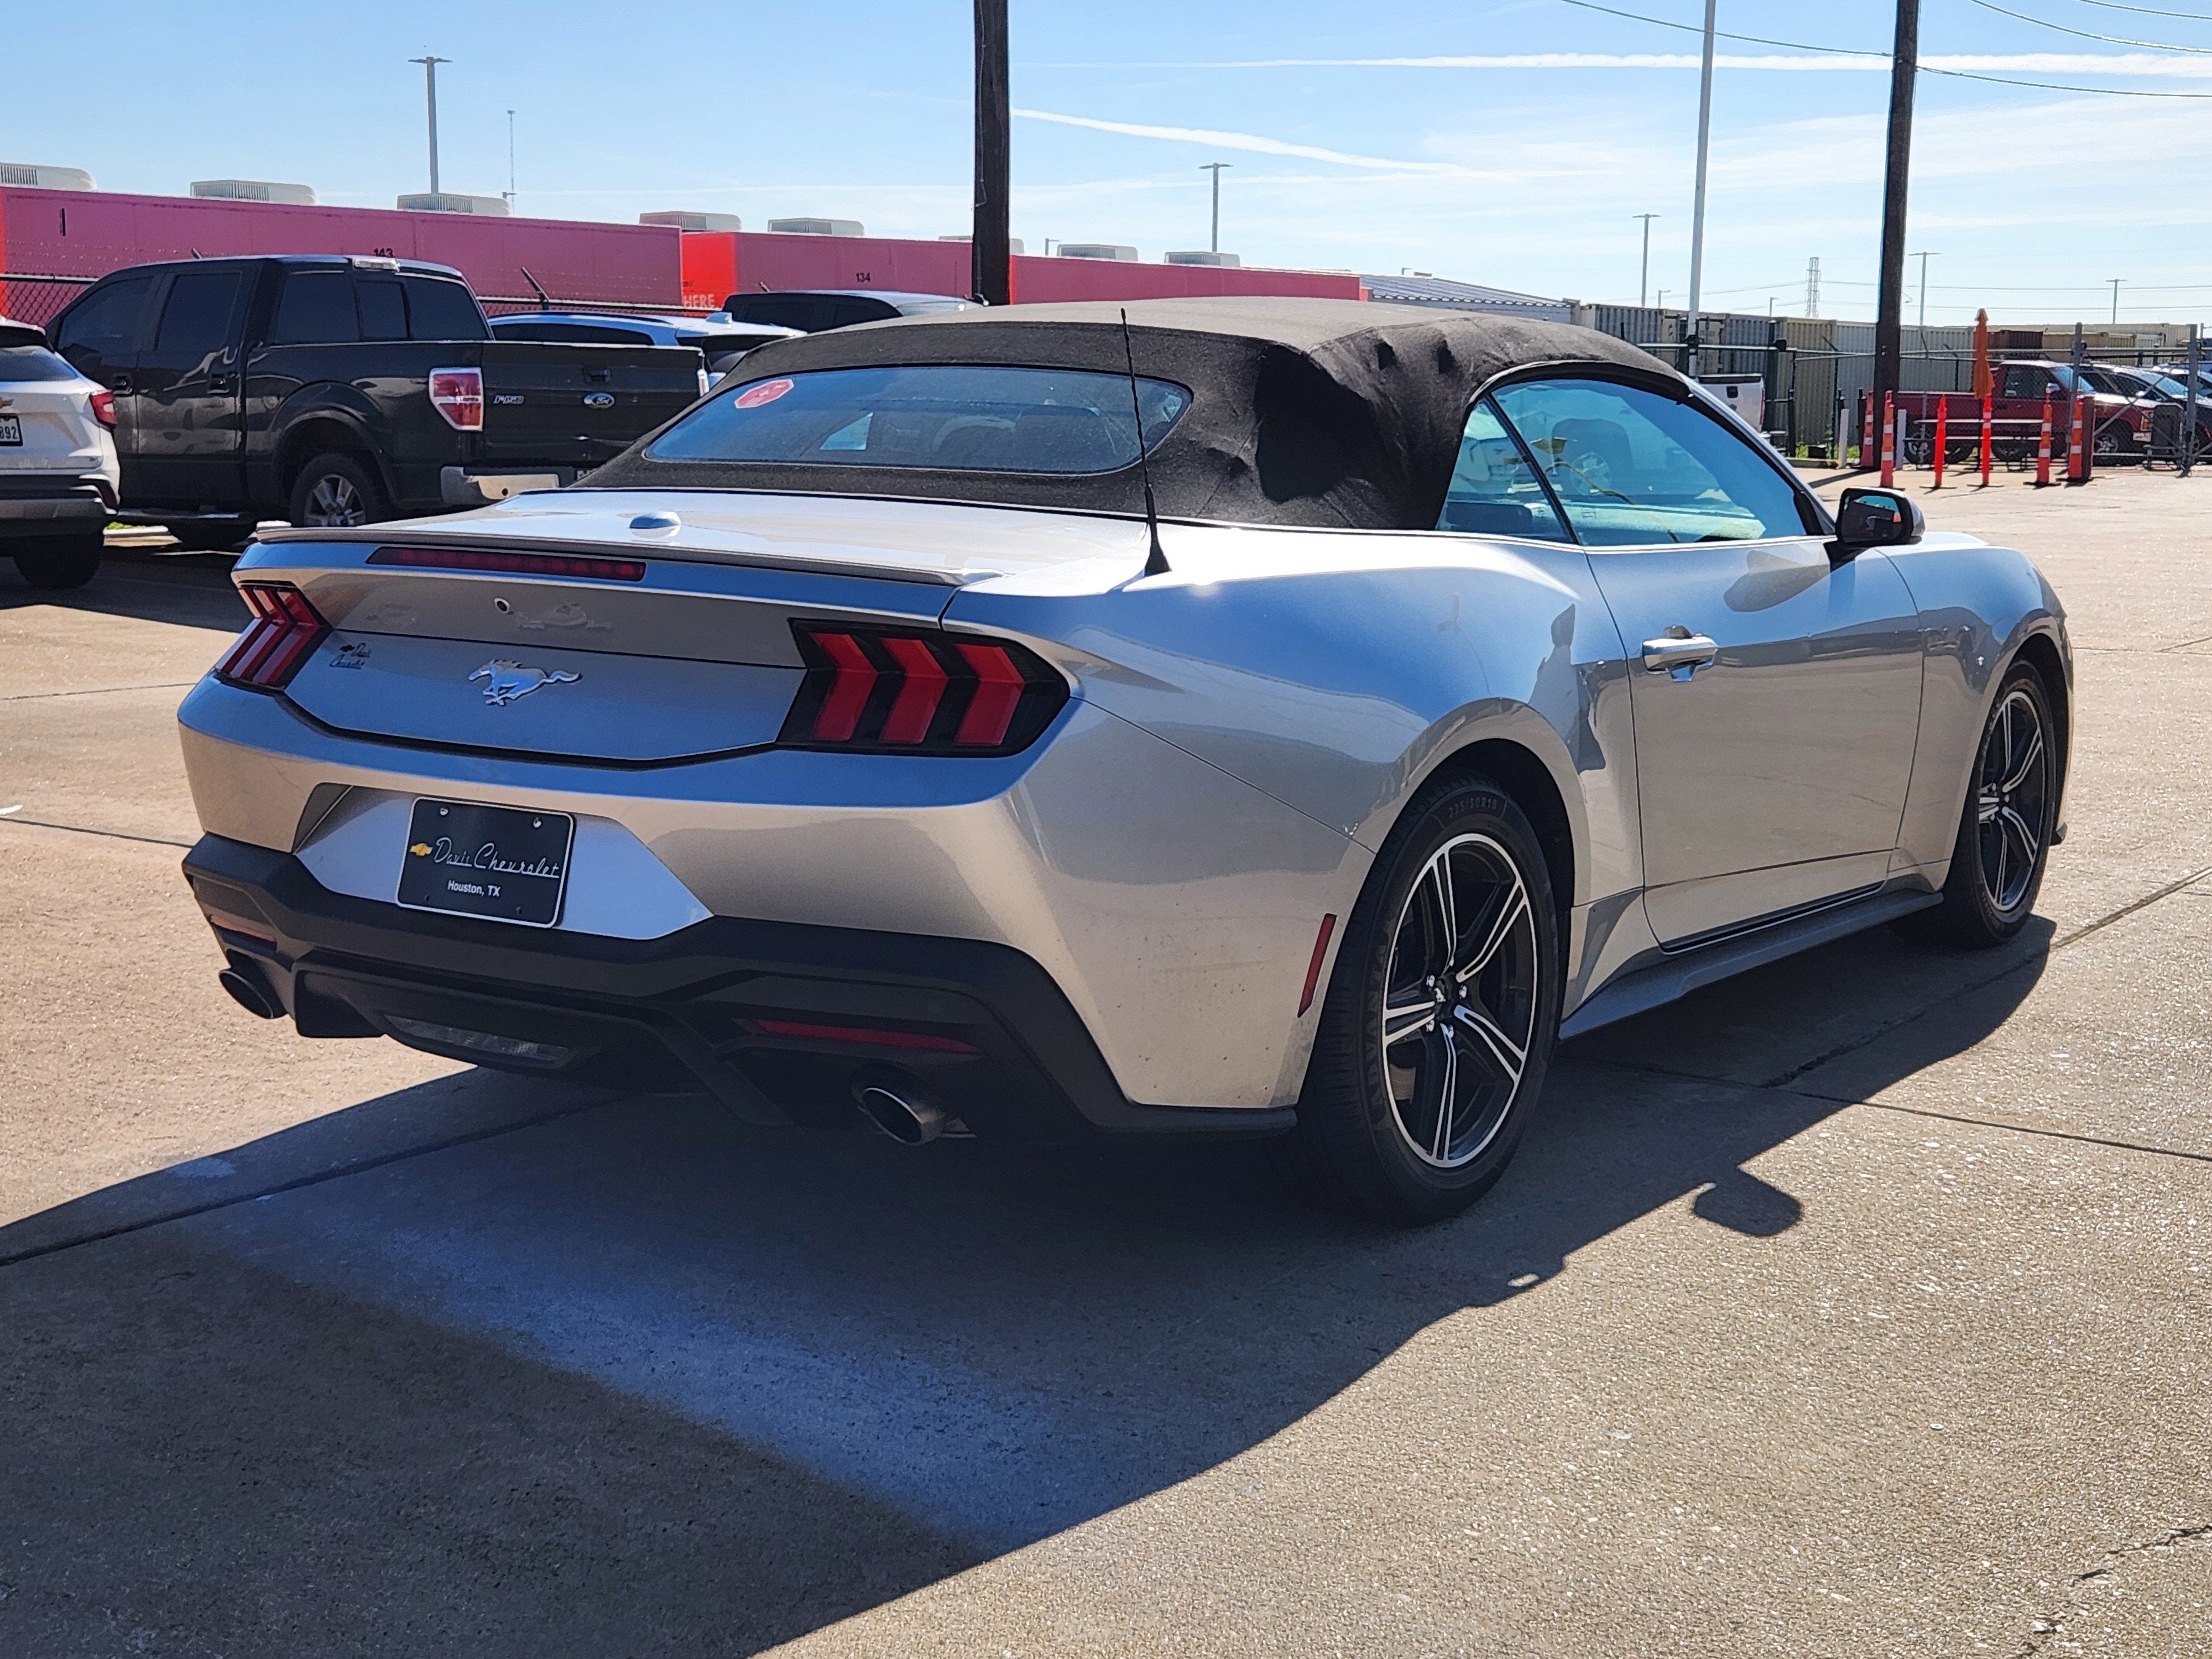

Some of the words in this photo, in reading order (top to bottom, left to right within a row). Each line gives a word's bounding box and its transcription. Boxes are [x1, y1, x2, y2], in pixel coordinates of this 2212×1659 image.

[856, 272, 871, 283] 134
[473, 842, 560, 879] Chevrolet
[447, 880, 484, 897] Houston,
[487, 885, 501, 897] TX
